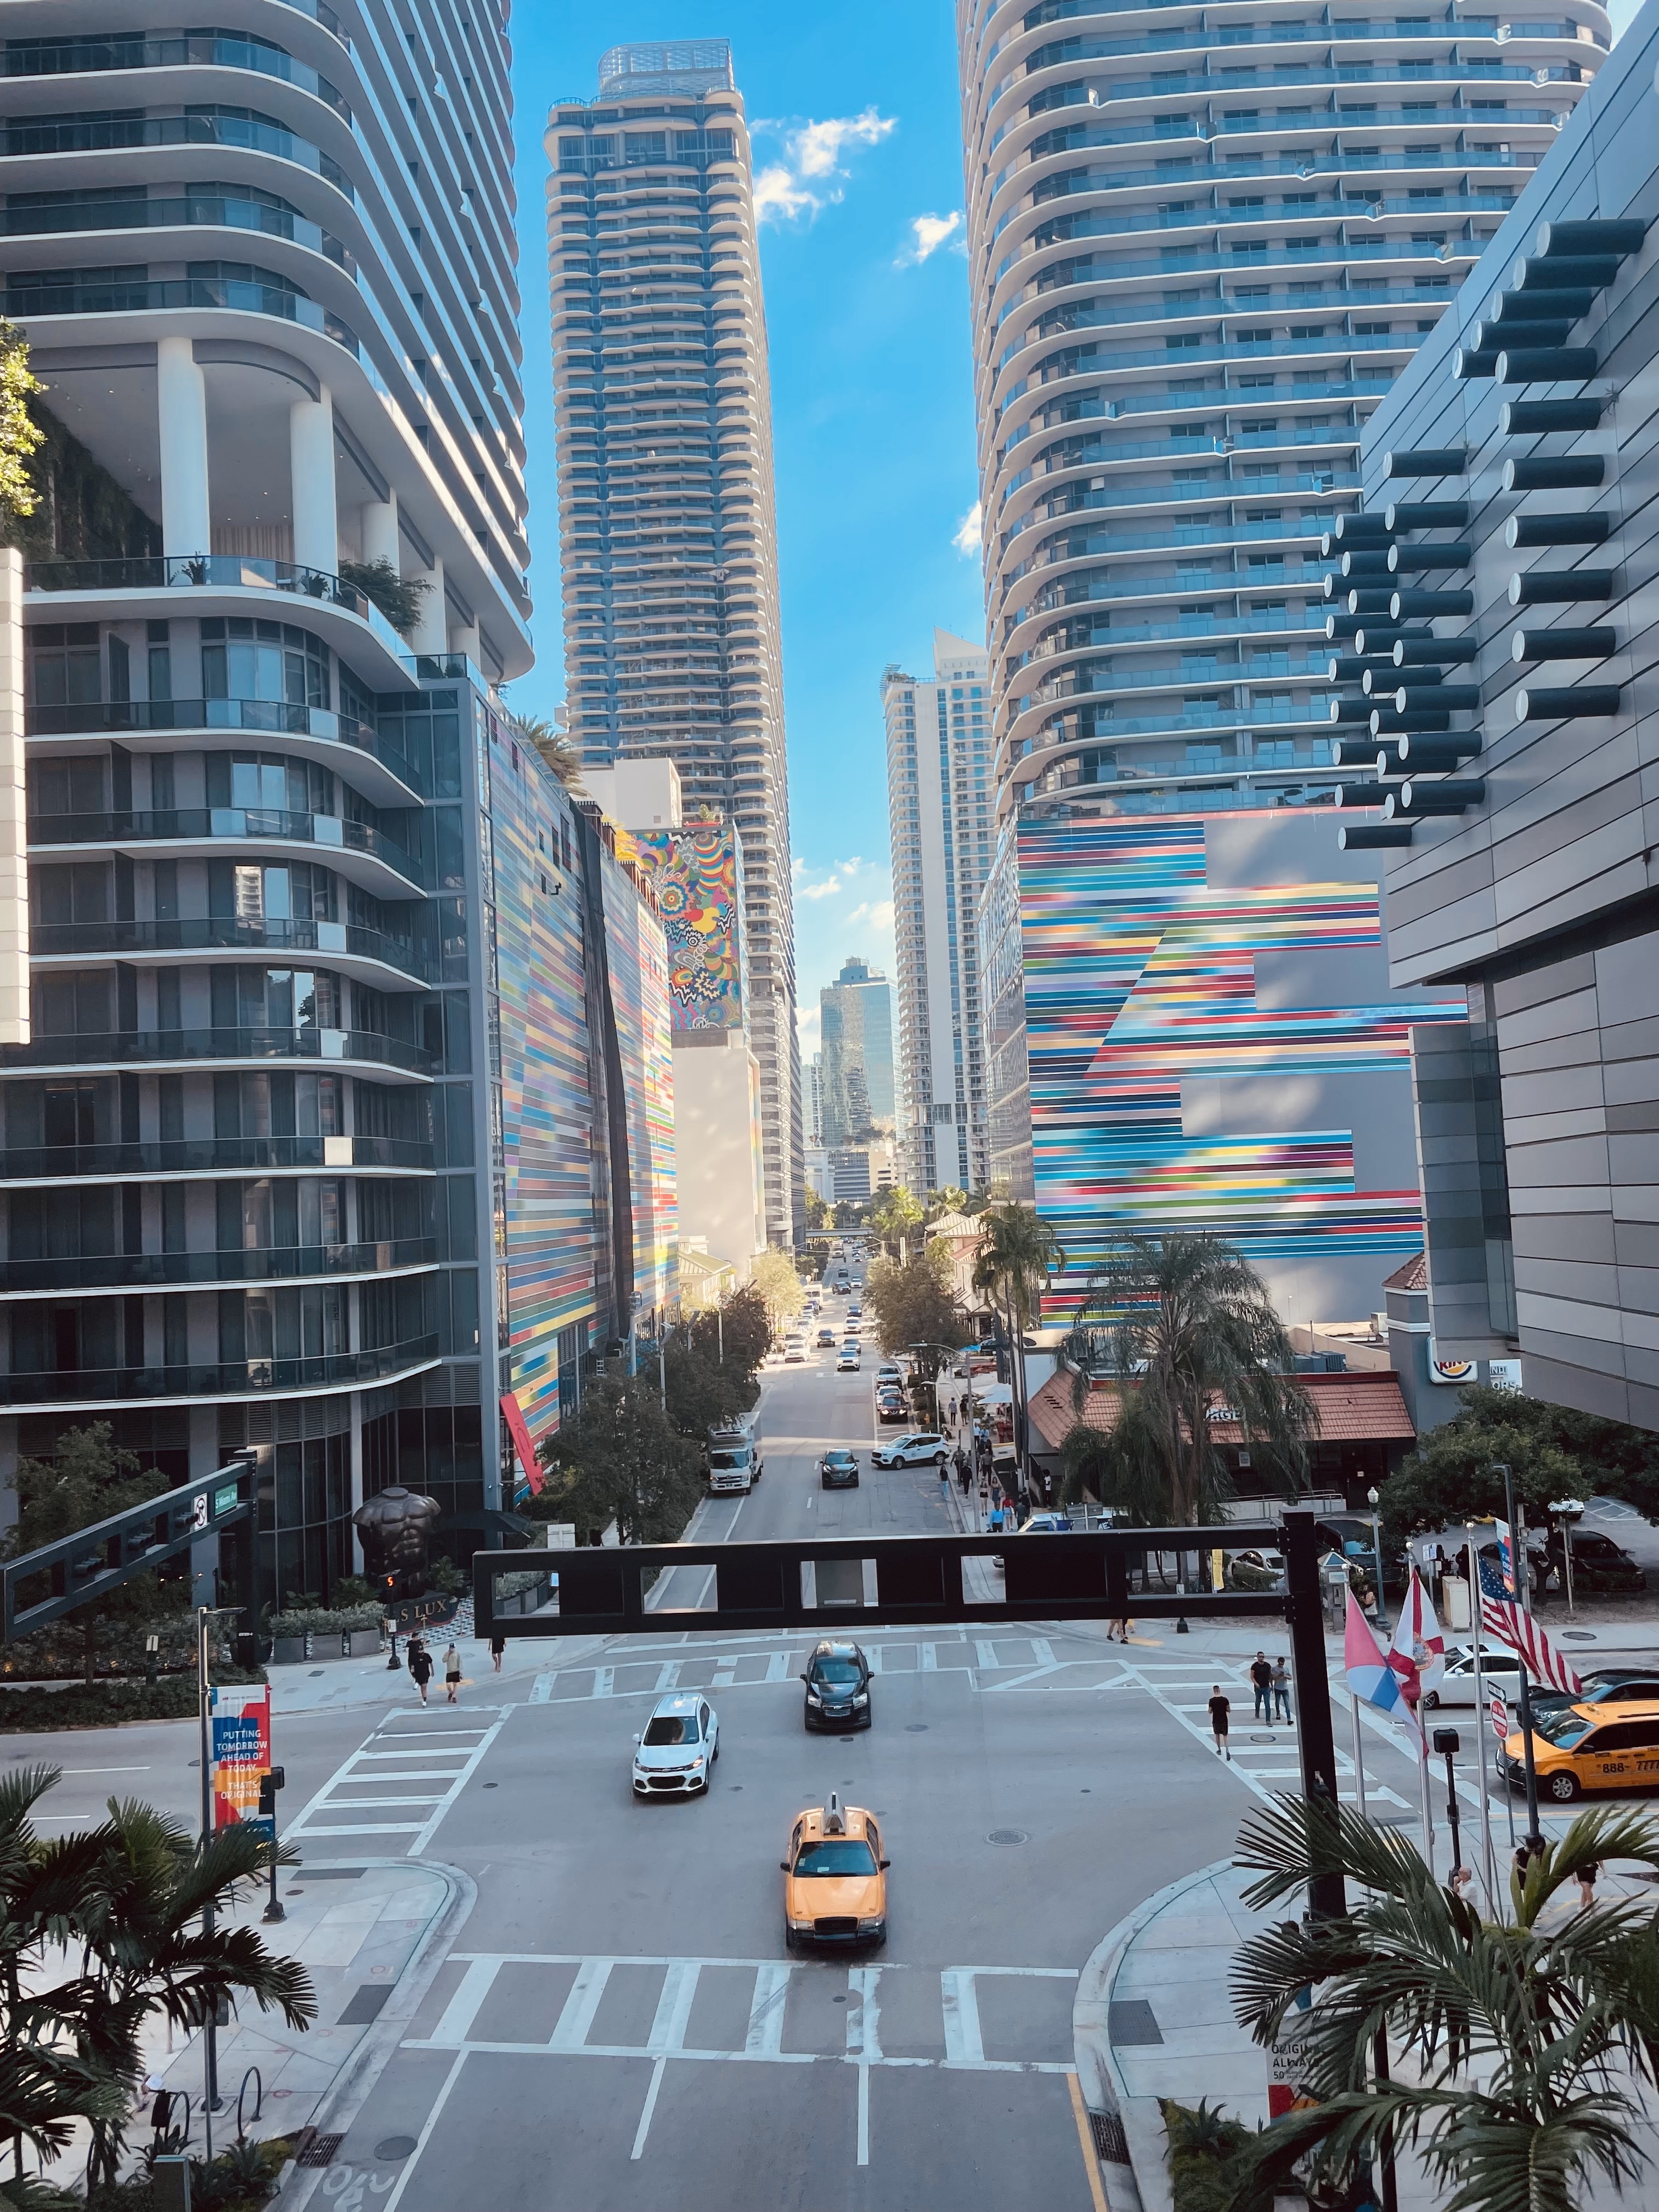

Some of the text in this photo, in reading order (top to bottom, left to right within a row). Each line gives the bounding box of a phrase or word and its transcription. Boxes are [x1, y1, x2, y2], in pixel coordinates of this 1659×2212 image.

[382, 1599, 447, 1623] SS LUX
[1495, 1721, 1506, 1733] ENTER
[223, 1729, 261, 1740] PUTTING
[216, 1740, 268, 1751] TOMORROW
[221, 1752, 264, 1763] AHEAD OF
[228, 1763, 257, 1773] TODAY.
[228, 1780, 257, 1790] THAT'S
